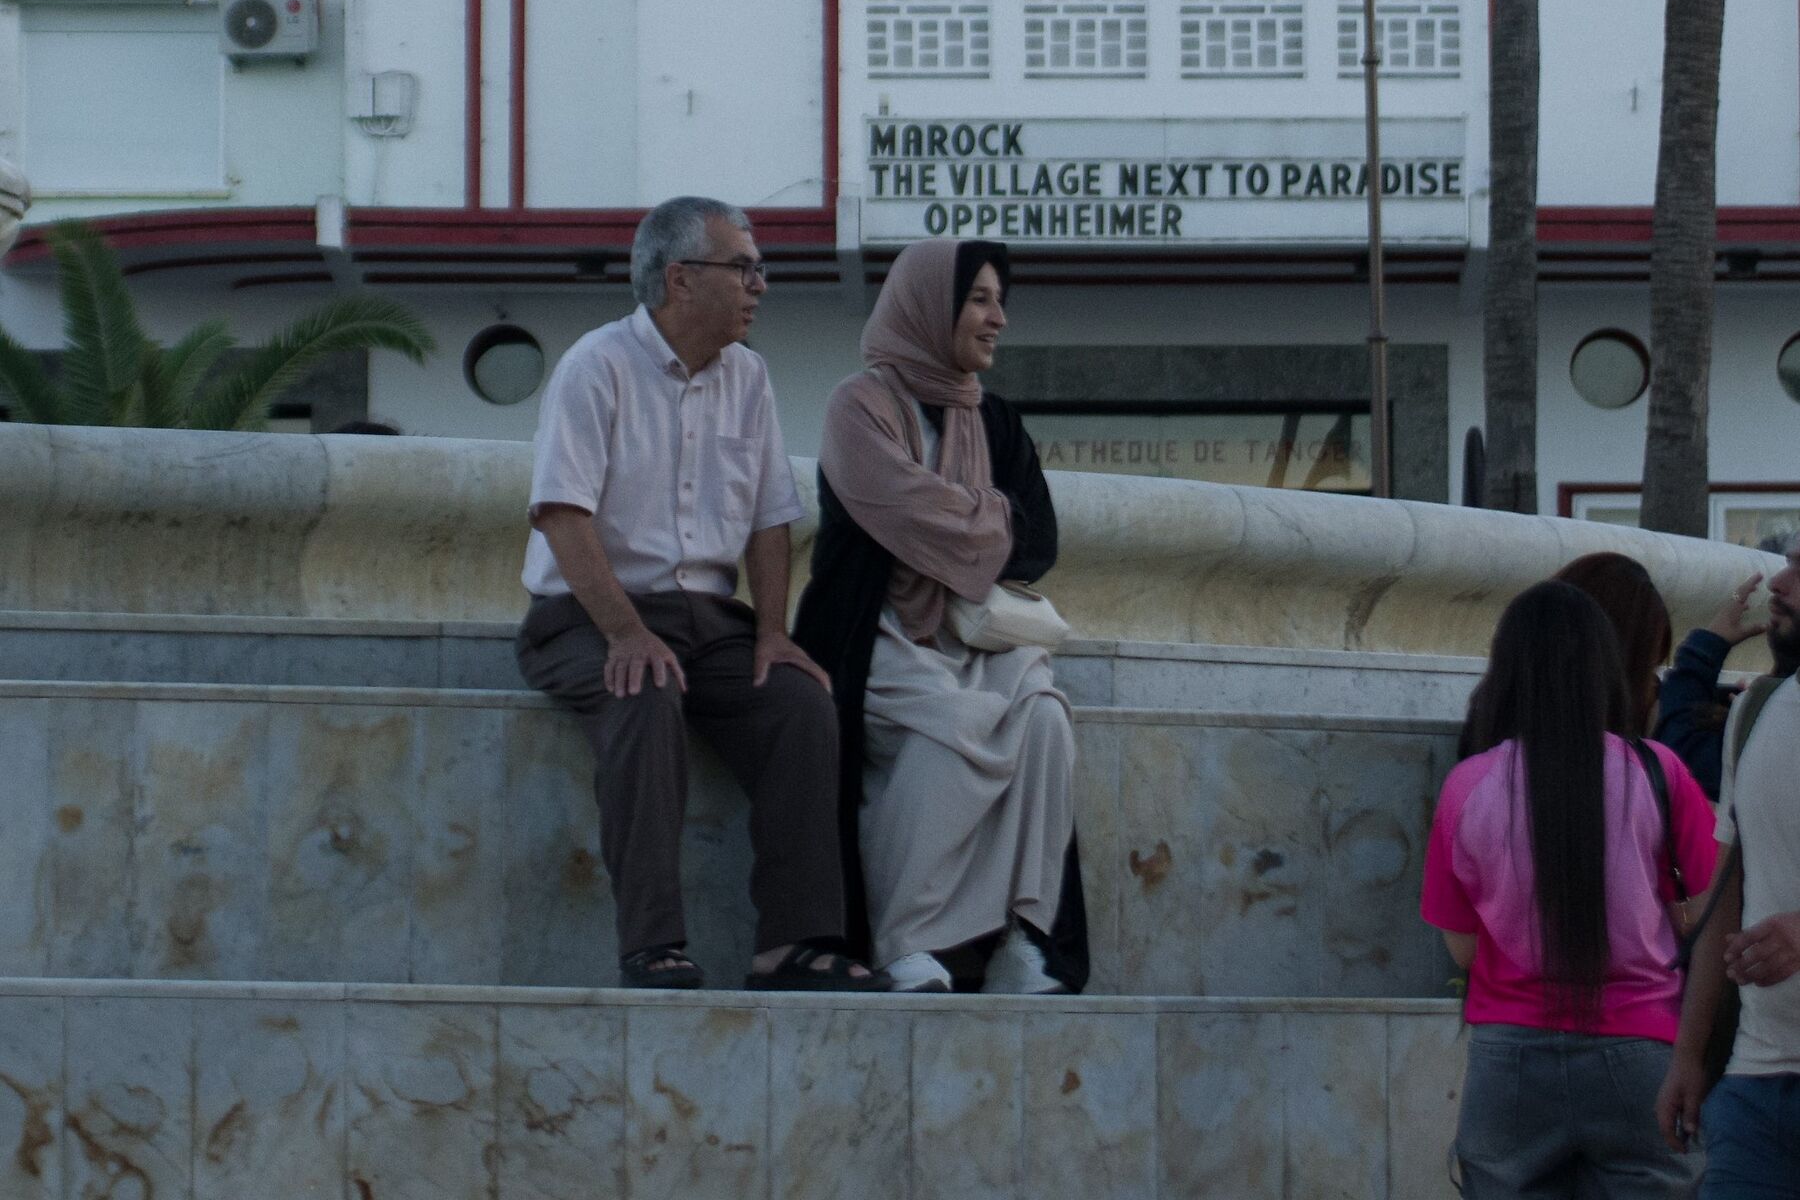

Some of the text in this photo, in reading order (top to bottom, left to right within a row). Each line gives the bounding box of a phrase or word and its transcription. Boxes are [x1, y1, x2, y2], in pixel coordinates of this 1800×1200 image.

[869, 123, 1024, 157] MAROCK
[869, 163, 936, 197] THE
[949, 163, 1102, 197] VILLAGE
[1118, 163, 1213, 197] NEXT
[1223, 163, 1270, 197] TO
[923, 202, 1183, 236] OPPENHEIMER
[1194, 440, 1226, 463] DE
